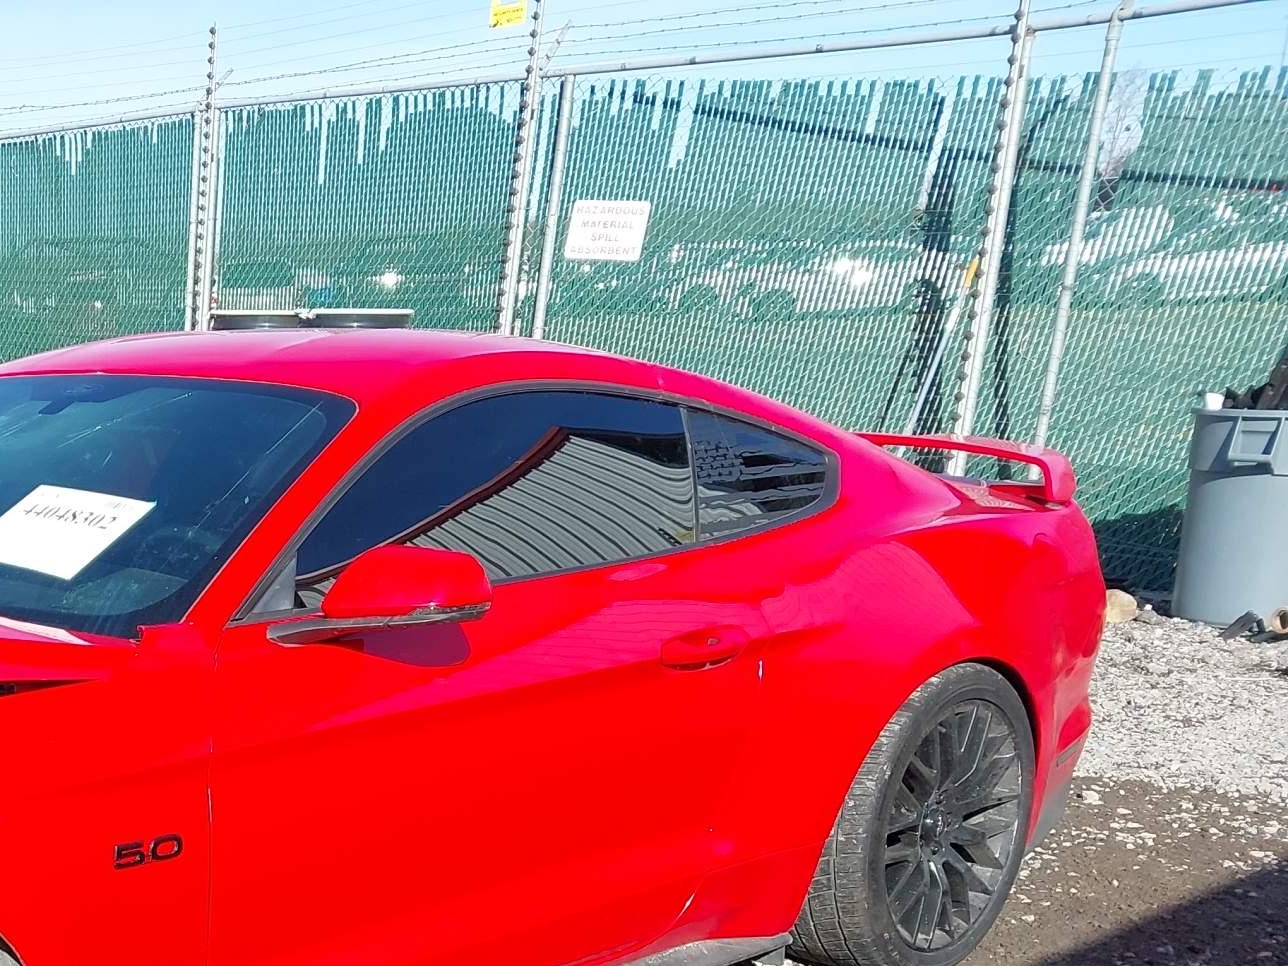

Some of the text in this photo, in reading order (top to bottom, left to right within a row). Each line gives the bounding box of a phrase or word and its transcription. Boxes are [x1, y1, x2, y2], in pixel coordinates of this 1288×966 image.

[576, 206, 646, 215] HAZARDOUS
[582, 220, 633, 229] MATERIAL
[590, 233, 620, 242] SPILL
[570, 246, 639, 255] ABSORBENT
[23, 504, 119, 530] 44048302
